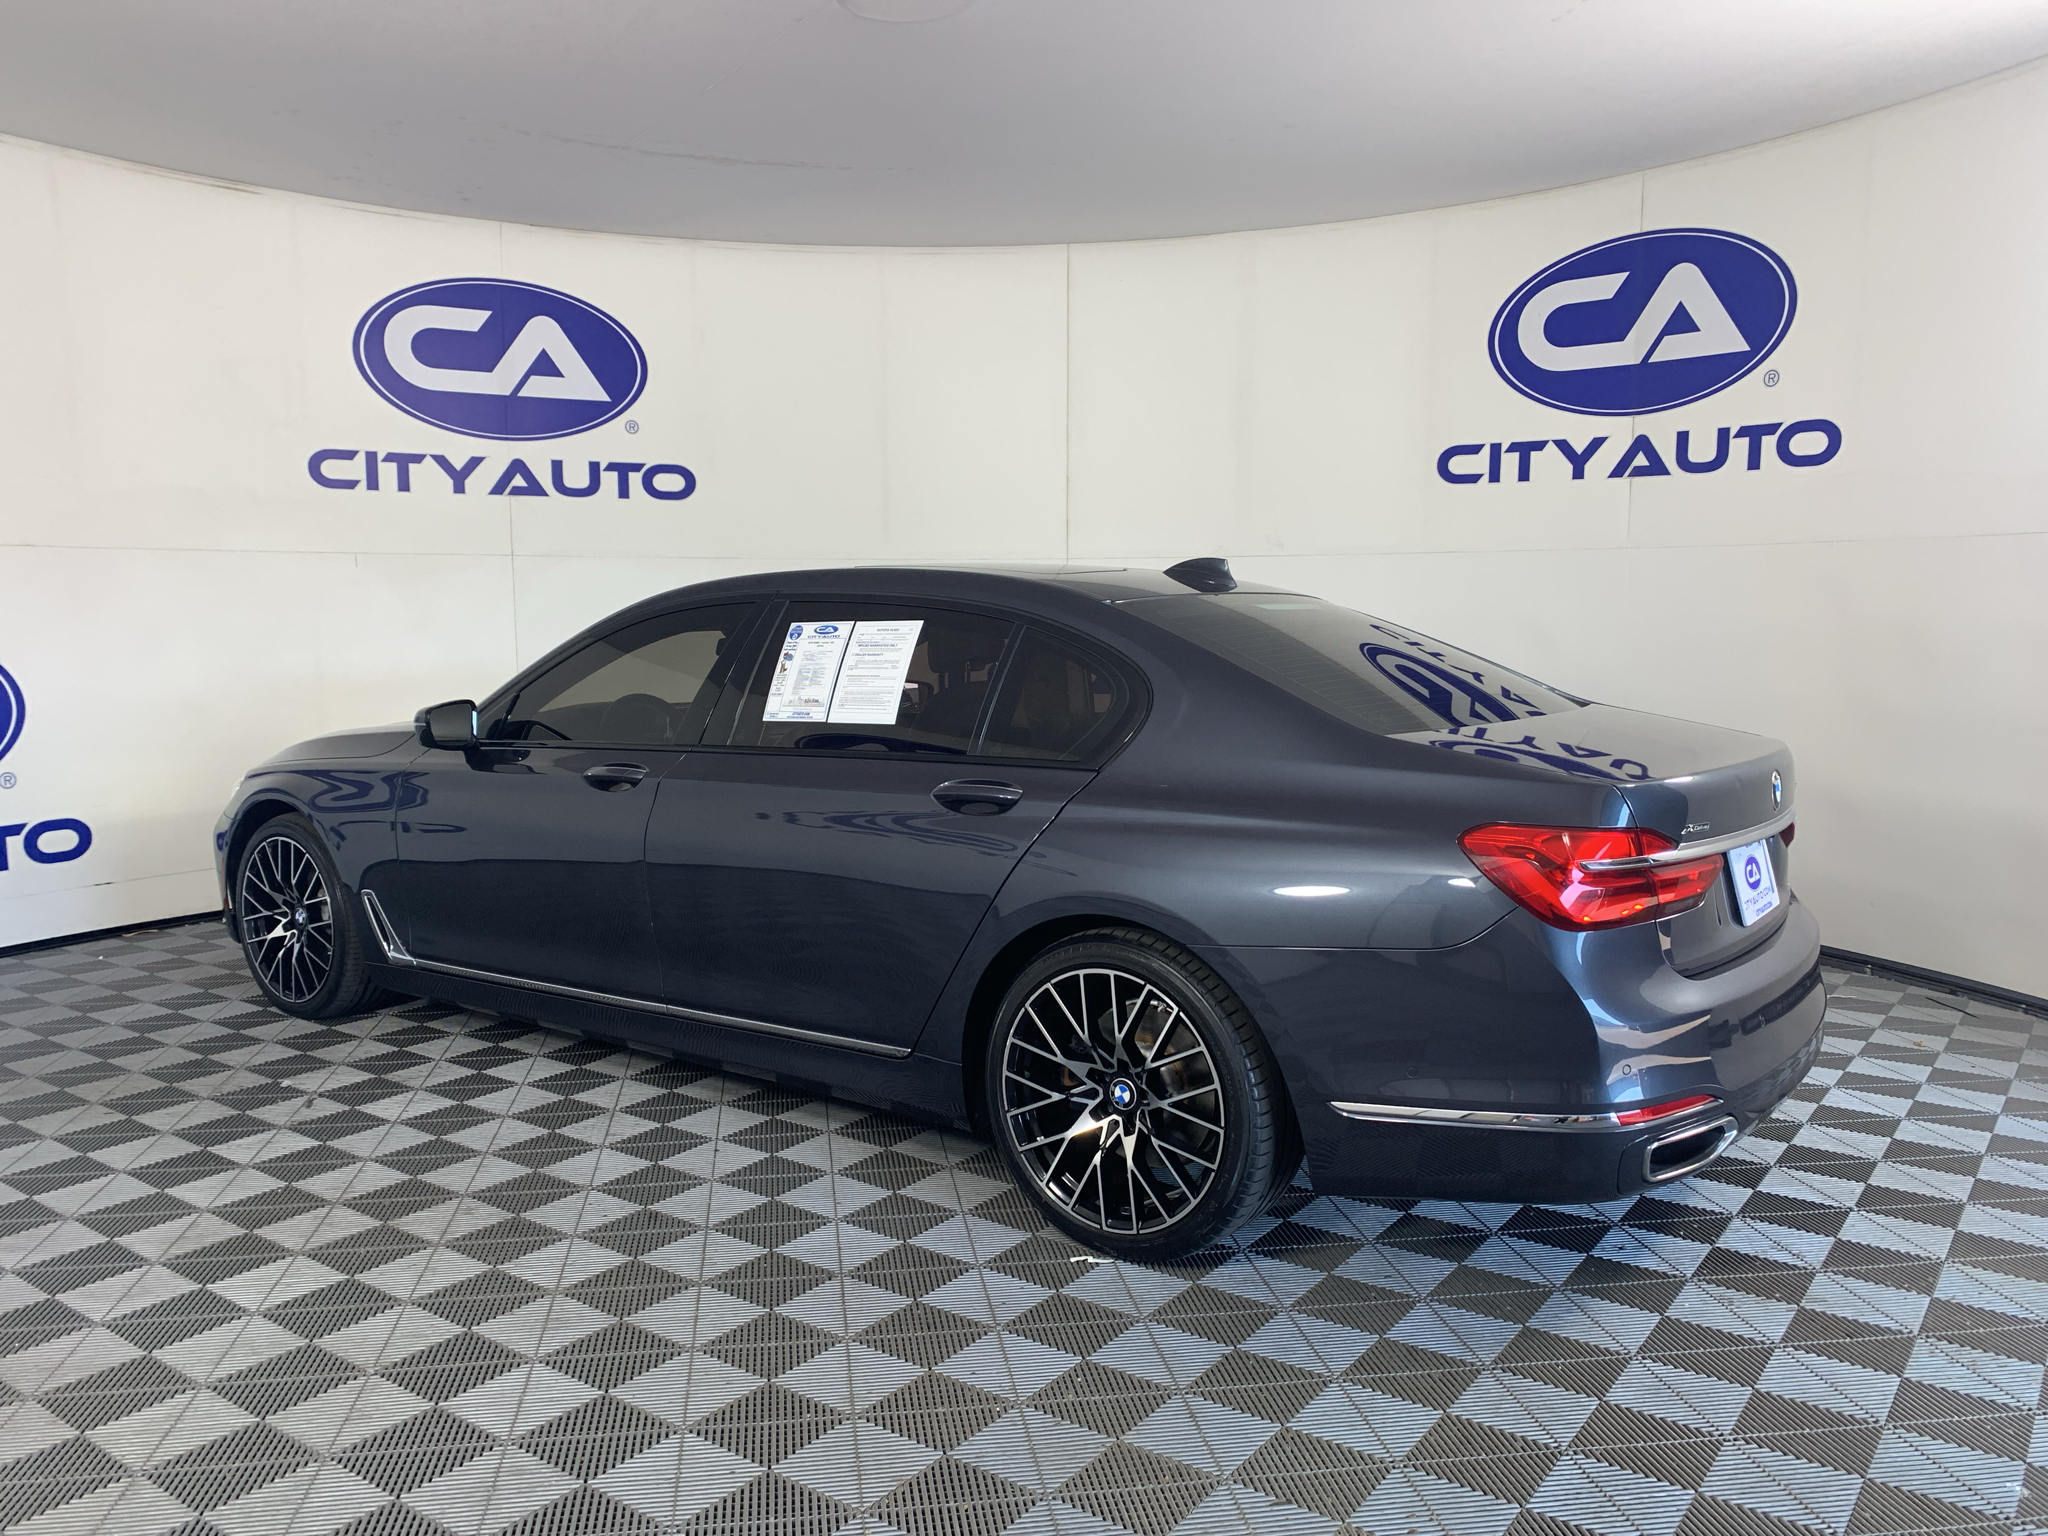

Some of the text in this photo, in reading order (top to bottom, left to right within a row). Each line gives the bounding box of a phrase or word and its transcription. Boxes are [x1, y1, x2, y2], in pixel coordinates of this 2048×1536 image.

[1518, 262, 1751, 371] CA
[384, 304, 612, 402] CA
[307, 448, 697, 500] CITY AUTO
[1437, 418, 1842, 484] CITY AUTO
[1746, 862, 1760, 884] CA
